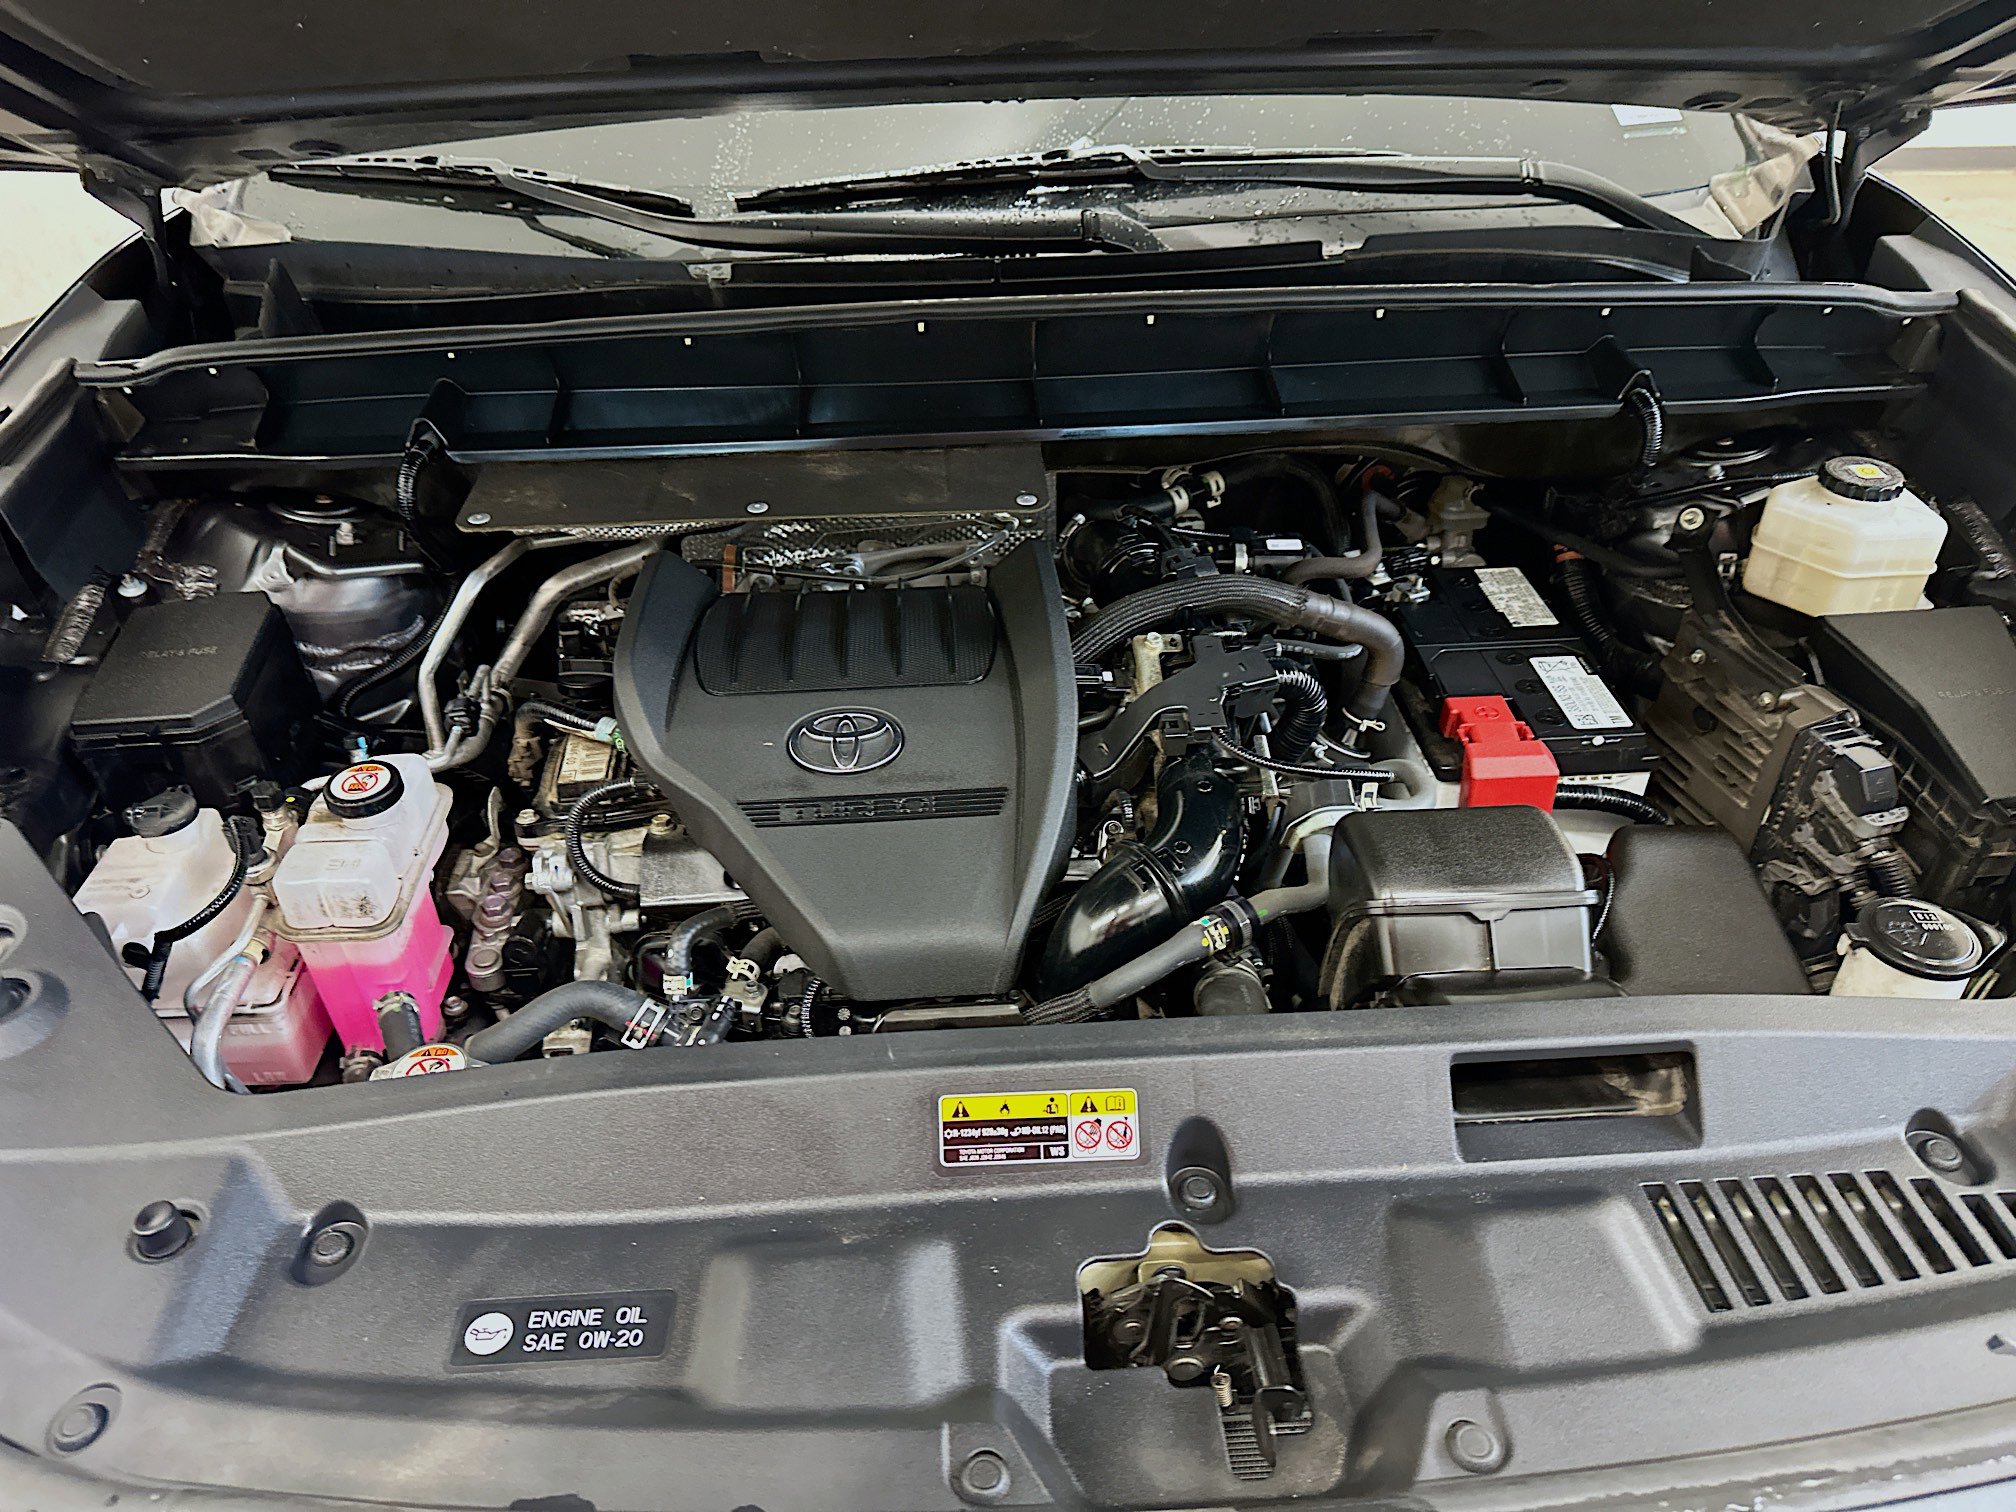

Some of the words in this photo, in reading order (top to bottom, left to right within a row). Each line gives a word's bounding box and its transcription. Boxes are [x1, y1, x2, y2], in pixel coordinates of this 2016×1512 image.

[1049, 1146, 1065, 1157] WS
[527, 1308, 604, 1329] ENGINE
[615, 1306, 648, 1325] OIL
[522, 1332, 567, 1352] SAE
[578, 1328, 644, 1349] 0W-20
